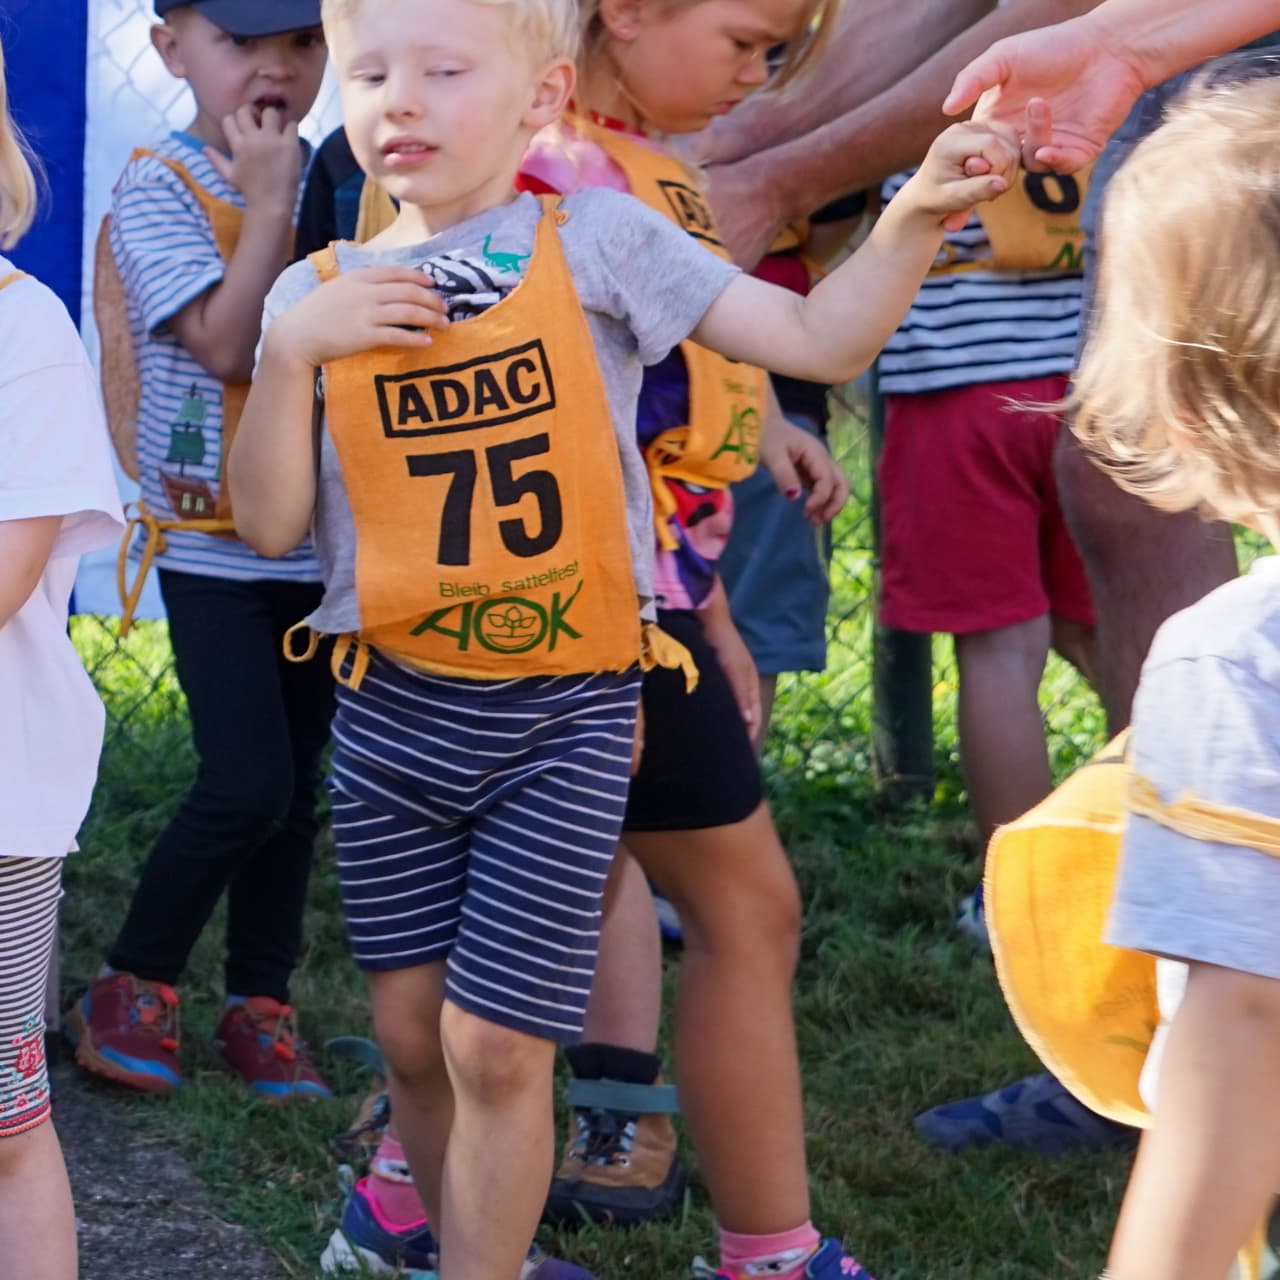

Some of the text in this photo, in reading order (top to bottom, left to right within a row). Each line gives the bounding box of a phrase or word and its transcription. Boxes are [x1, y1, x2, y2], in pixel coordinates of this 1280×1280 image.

[396, 357, 541, 425] ADAC
[405, 433, 563, 567] 75
[409, 579, 584, 655] AOK
[439, 581, 491, 599] Bleib
